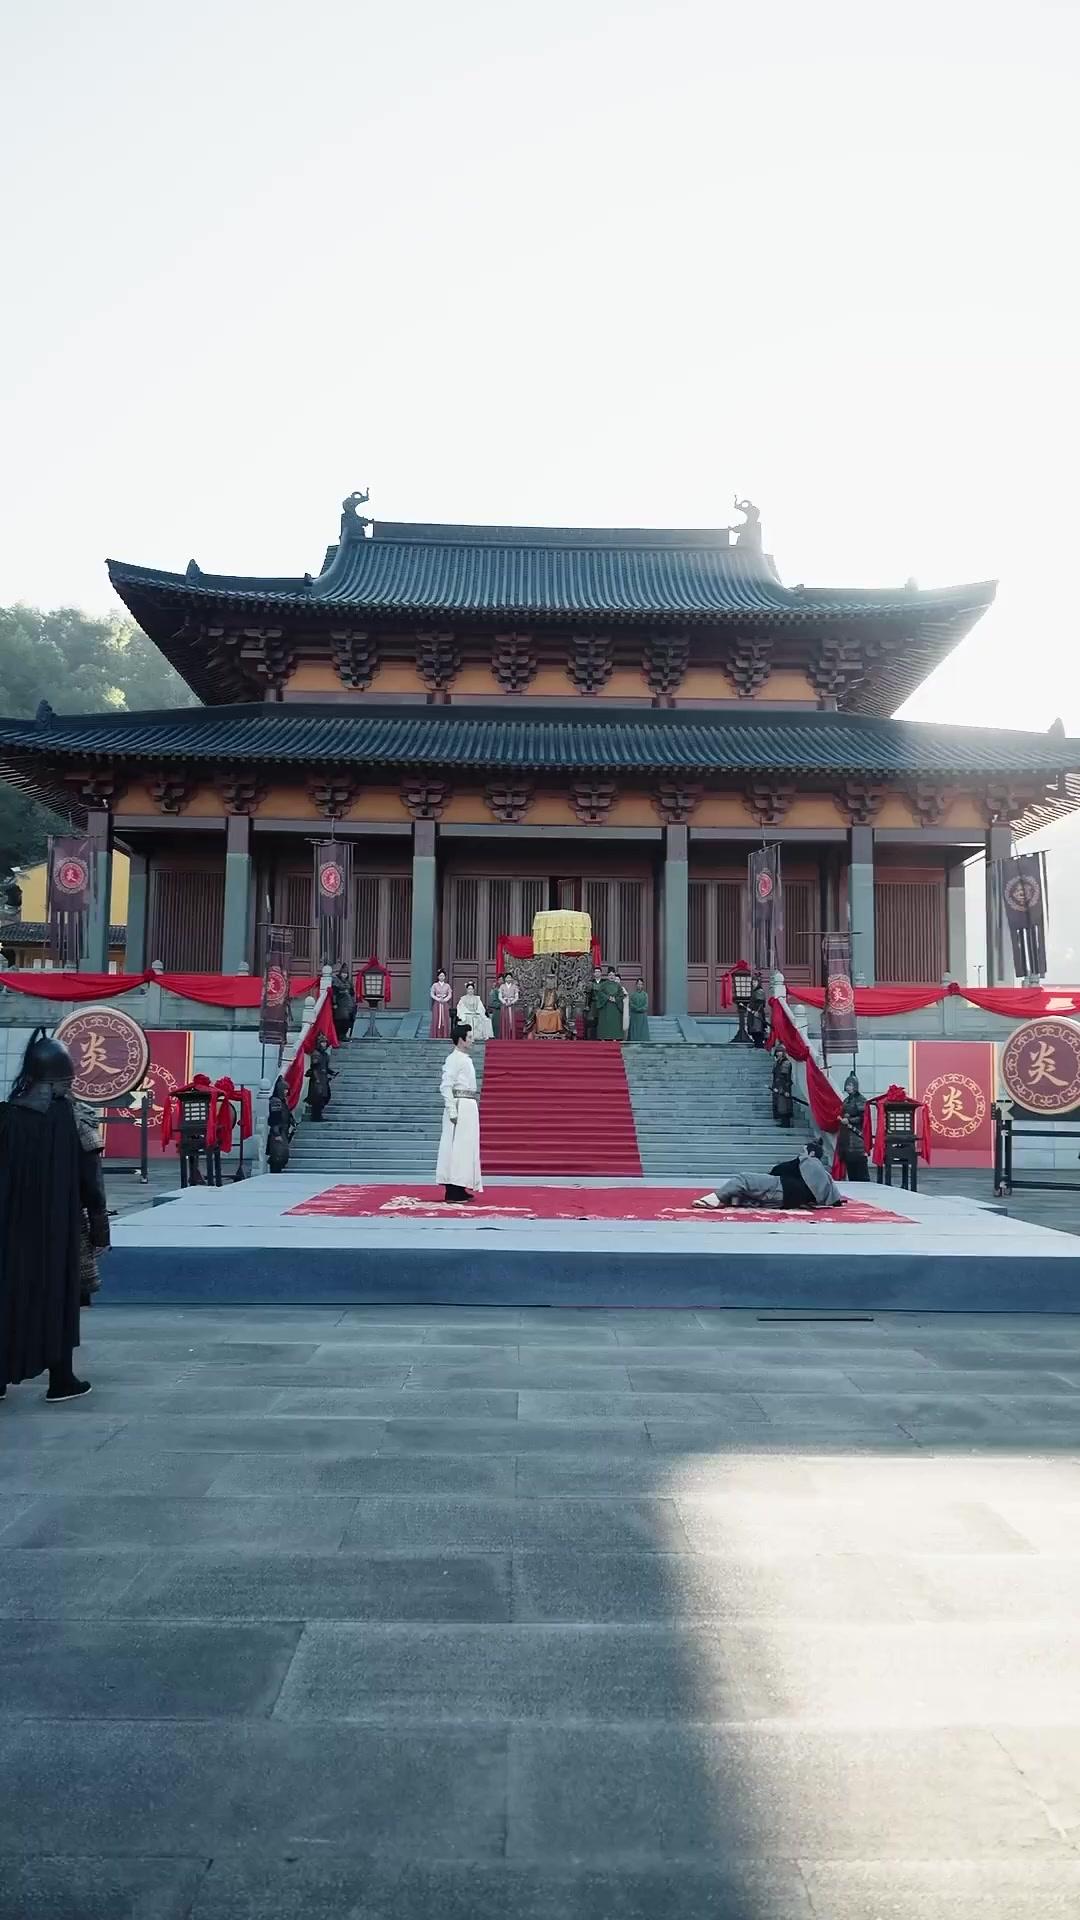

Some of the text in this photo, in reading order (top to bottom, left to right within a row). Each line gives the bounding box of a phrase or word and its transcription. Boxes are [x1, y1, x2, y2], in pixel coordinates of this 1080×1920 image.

[80, 1031, 122, 1077] 炎
[1026, 1040, 1070, 1087] 炎
[942, 1086, 975, 1122] 炎
